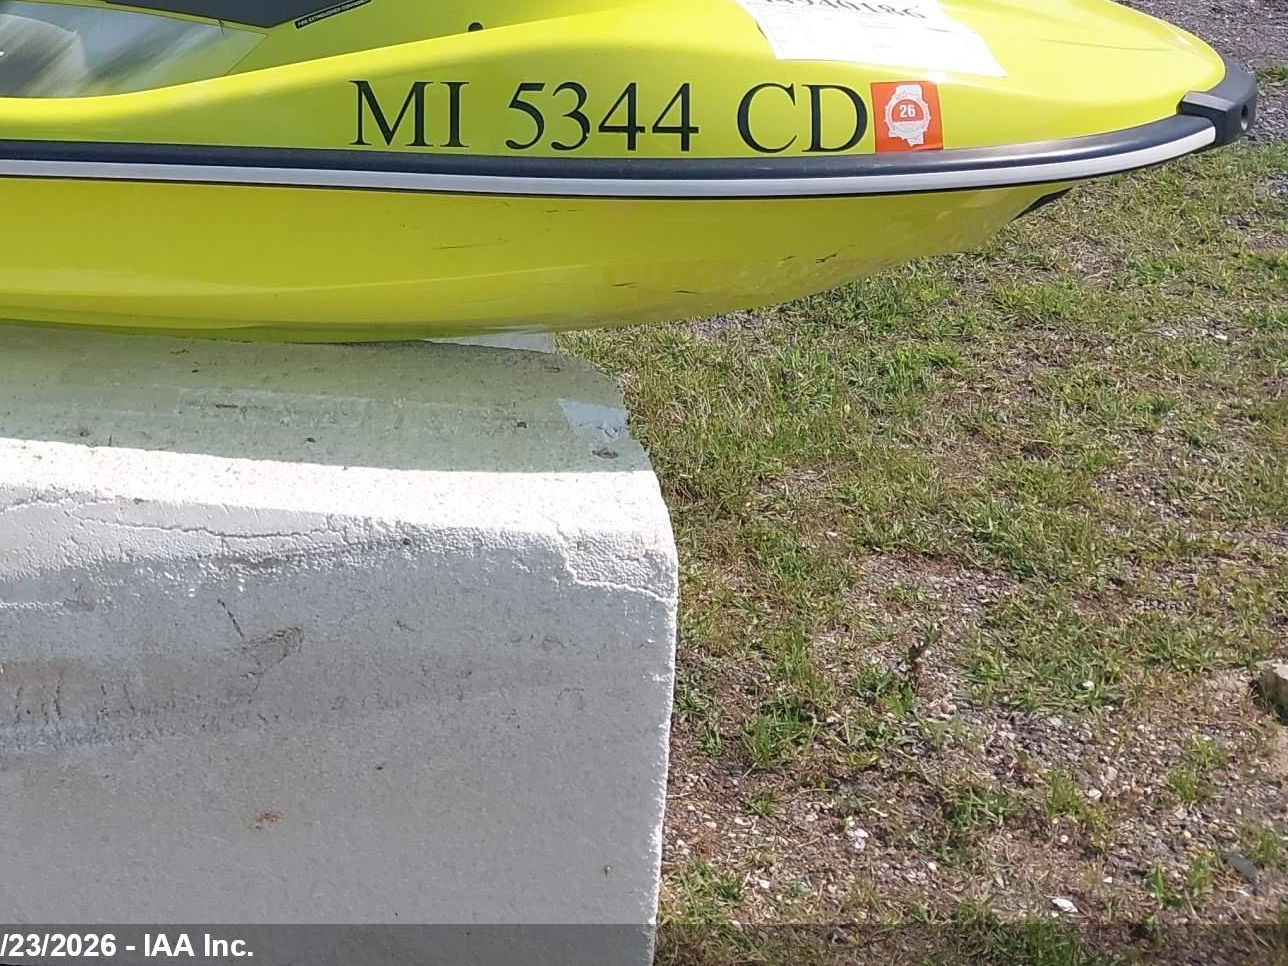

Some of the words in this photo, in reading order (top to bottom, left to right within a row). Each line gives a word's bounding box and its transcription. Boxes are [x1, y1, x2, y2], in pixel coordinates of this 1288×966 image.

[348, 80, 470, 148] MI
[505, 81, 700, 152] 5344
[736, 82, 869, 154] CD
[898, 104, 917, 119] 26
